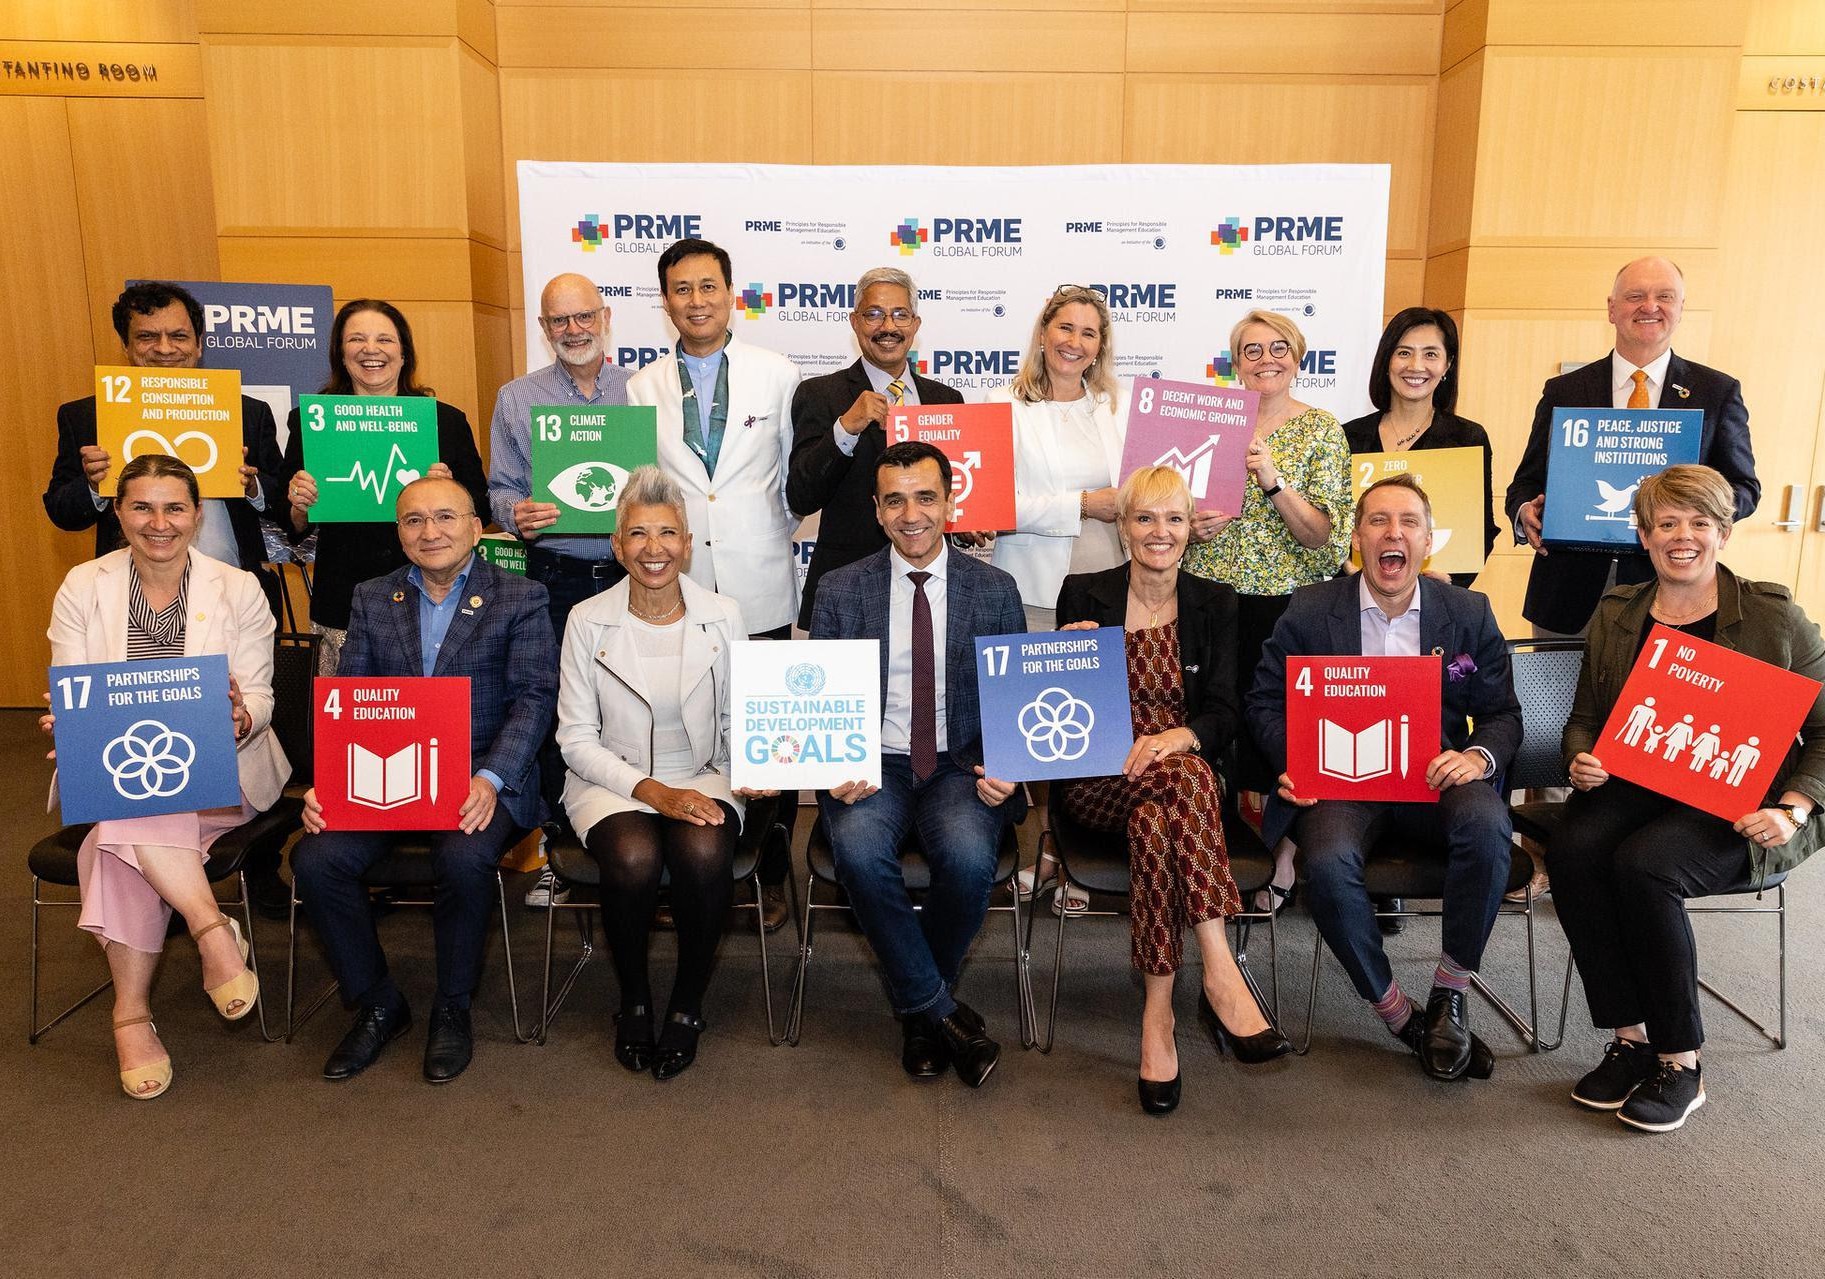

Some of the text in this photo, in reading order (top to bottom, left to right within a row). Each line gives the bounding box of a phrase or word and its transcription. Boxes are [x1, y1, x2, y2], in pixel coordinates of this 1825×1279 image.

[98, 63, 158, 82] ROOM
[615, 243, 659, 253] GLOBAL
[934, 246, 1022, 257] GLOBAL FORUM
[1254, 245, 1342, 256] GLOBAL FORUM
[779, 311, 849, 322] GLOBAL FOR
[1136, 312, 1176, 322] FORUM
[206, 335, 317, 350] GLOBAL FORUM
[101, 375, 132, 403] 12
[141, 376, 208, 390] RESPONSIBLE
[1295, 378, 1336, 389] FORUM
[141, 392, 214, 405] CONSUMPTION
[1138, 387, 1155, 414] 8
[1162, 390, 1244, 410] DECENT WORK AND
[142, 408, 230, 421] AND PRODUCTION
[308, 404, 326, 432] 3
[334, 405, 403, 417] GOOD HEALTH
[1160, 405, 1247, 427] ECONOMIC GROWTH
[336, 420, 418, 432] AND WELL-BEING
[570, 415, 607, 426] CLIMATE
[918, 414, 953, 426] GENDER
[1597, 419, 1683, 434] PEACE, JUSTICE
[536, 415, 562, 441] 13
[570, 430, 602, 441] ACTION
[894, 415, 910, 442] 5
[919, 429, 961, 442] EQUALITY
[1562, 418, 1590, 447] 16
[1596, 436, 1664, 450] AND STRONG
[1383, 459, 1408, 472] ZERO
[1594, 451, 1668, 466] INSTITUTIONS
[1360, 462, 1375, 488] 2
[494, 546, 514, 558] GOOD
[495, 559, 509, 569] AND
[1021, 639, 1098, 657] PARTNERSHIPS
[1647, 638, 1669, 669] 1
[1675, 645, 1697, 662] NO
[982, 646, 1010, 677] 17
[1023, 656, 1100, 674] FOR THE GOALS
[106, 667, 200, 687] PARTNERSHIPS
[1324, 666, 1371, 681] QUALITY
[1667, 663, 1725, 693] POVERTY
[1295, 667, 1314, 697] 4
[57, 676, 92, 710] 17
[108, 686, 202, 706] FOR THE GOALS
[353, 688, 400, 703] QUALITY
[1324, 684, 1386, 697] EDUCATION
[323, 688, 343, 720] 4
[745, 699, 866, 715] SUSTAINABLE
[353, 707, 416, 720] EDUCATION
[745, 717, 866, 732] DEVELOPMENT
